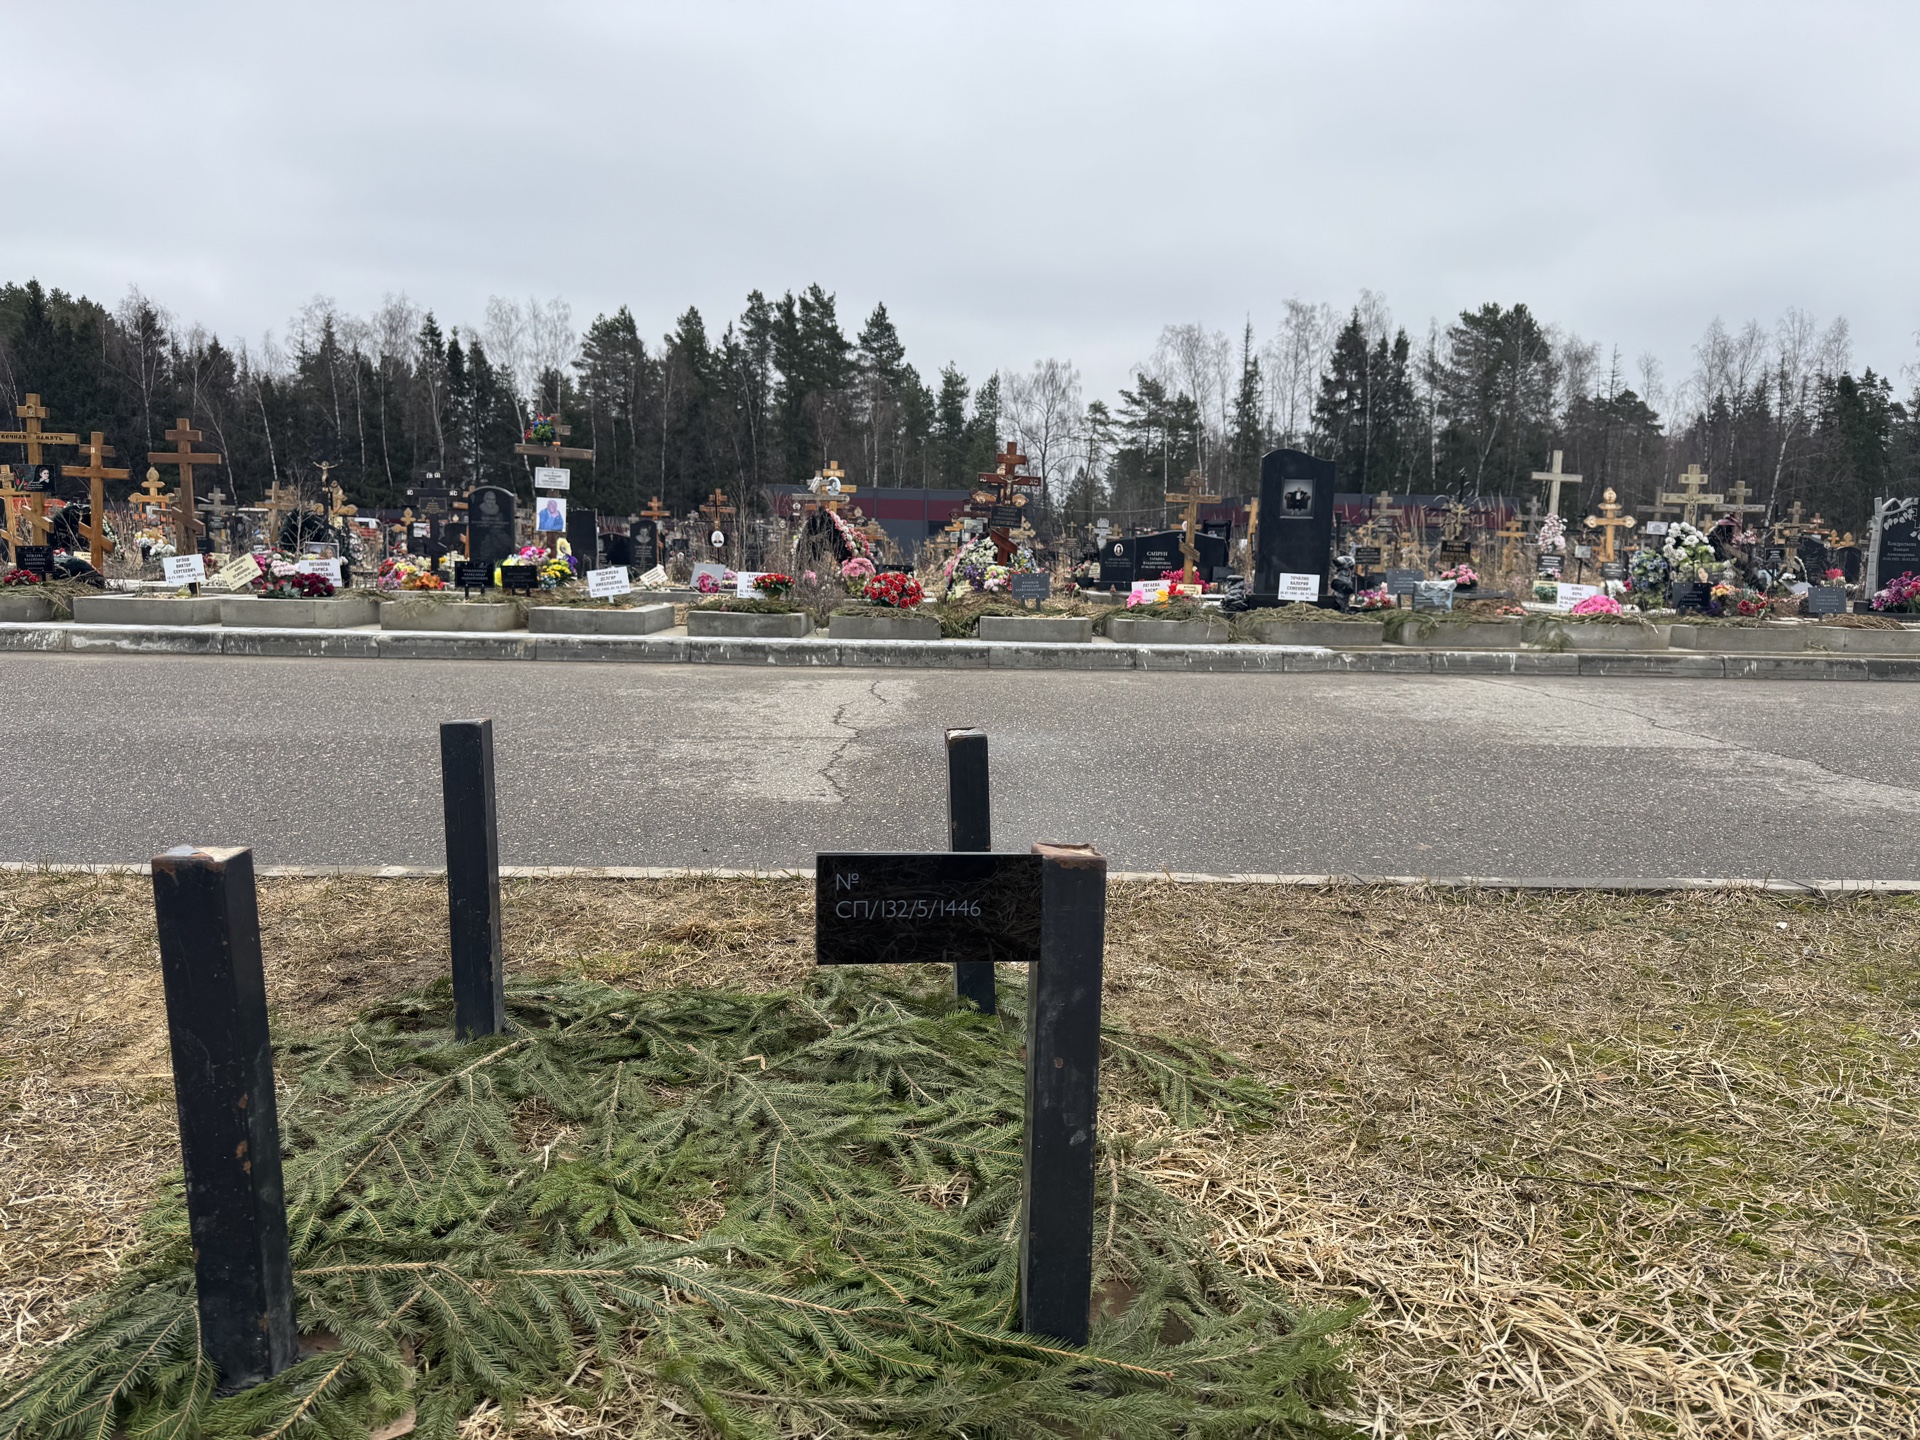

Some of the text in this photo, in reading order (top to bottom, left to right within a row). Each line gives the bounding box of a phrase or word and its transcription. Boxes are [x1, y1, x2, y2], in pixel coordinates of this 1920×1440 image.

[595, 569, 619, 577] ЛИДЖИЕВА
[595, 579, 623, 587] НИКОЛАЕВНА
[835, 873, 859, 891] №
[835, 899, 982, 920] СП/132/5/1446
